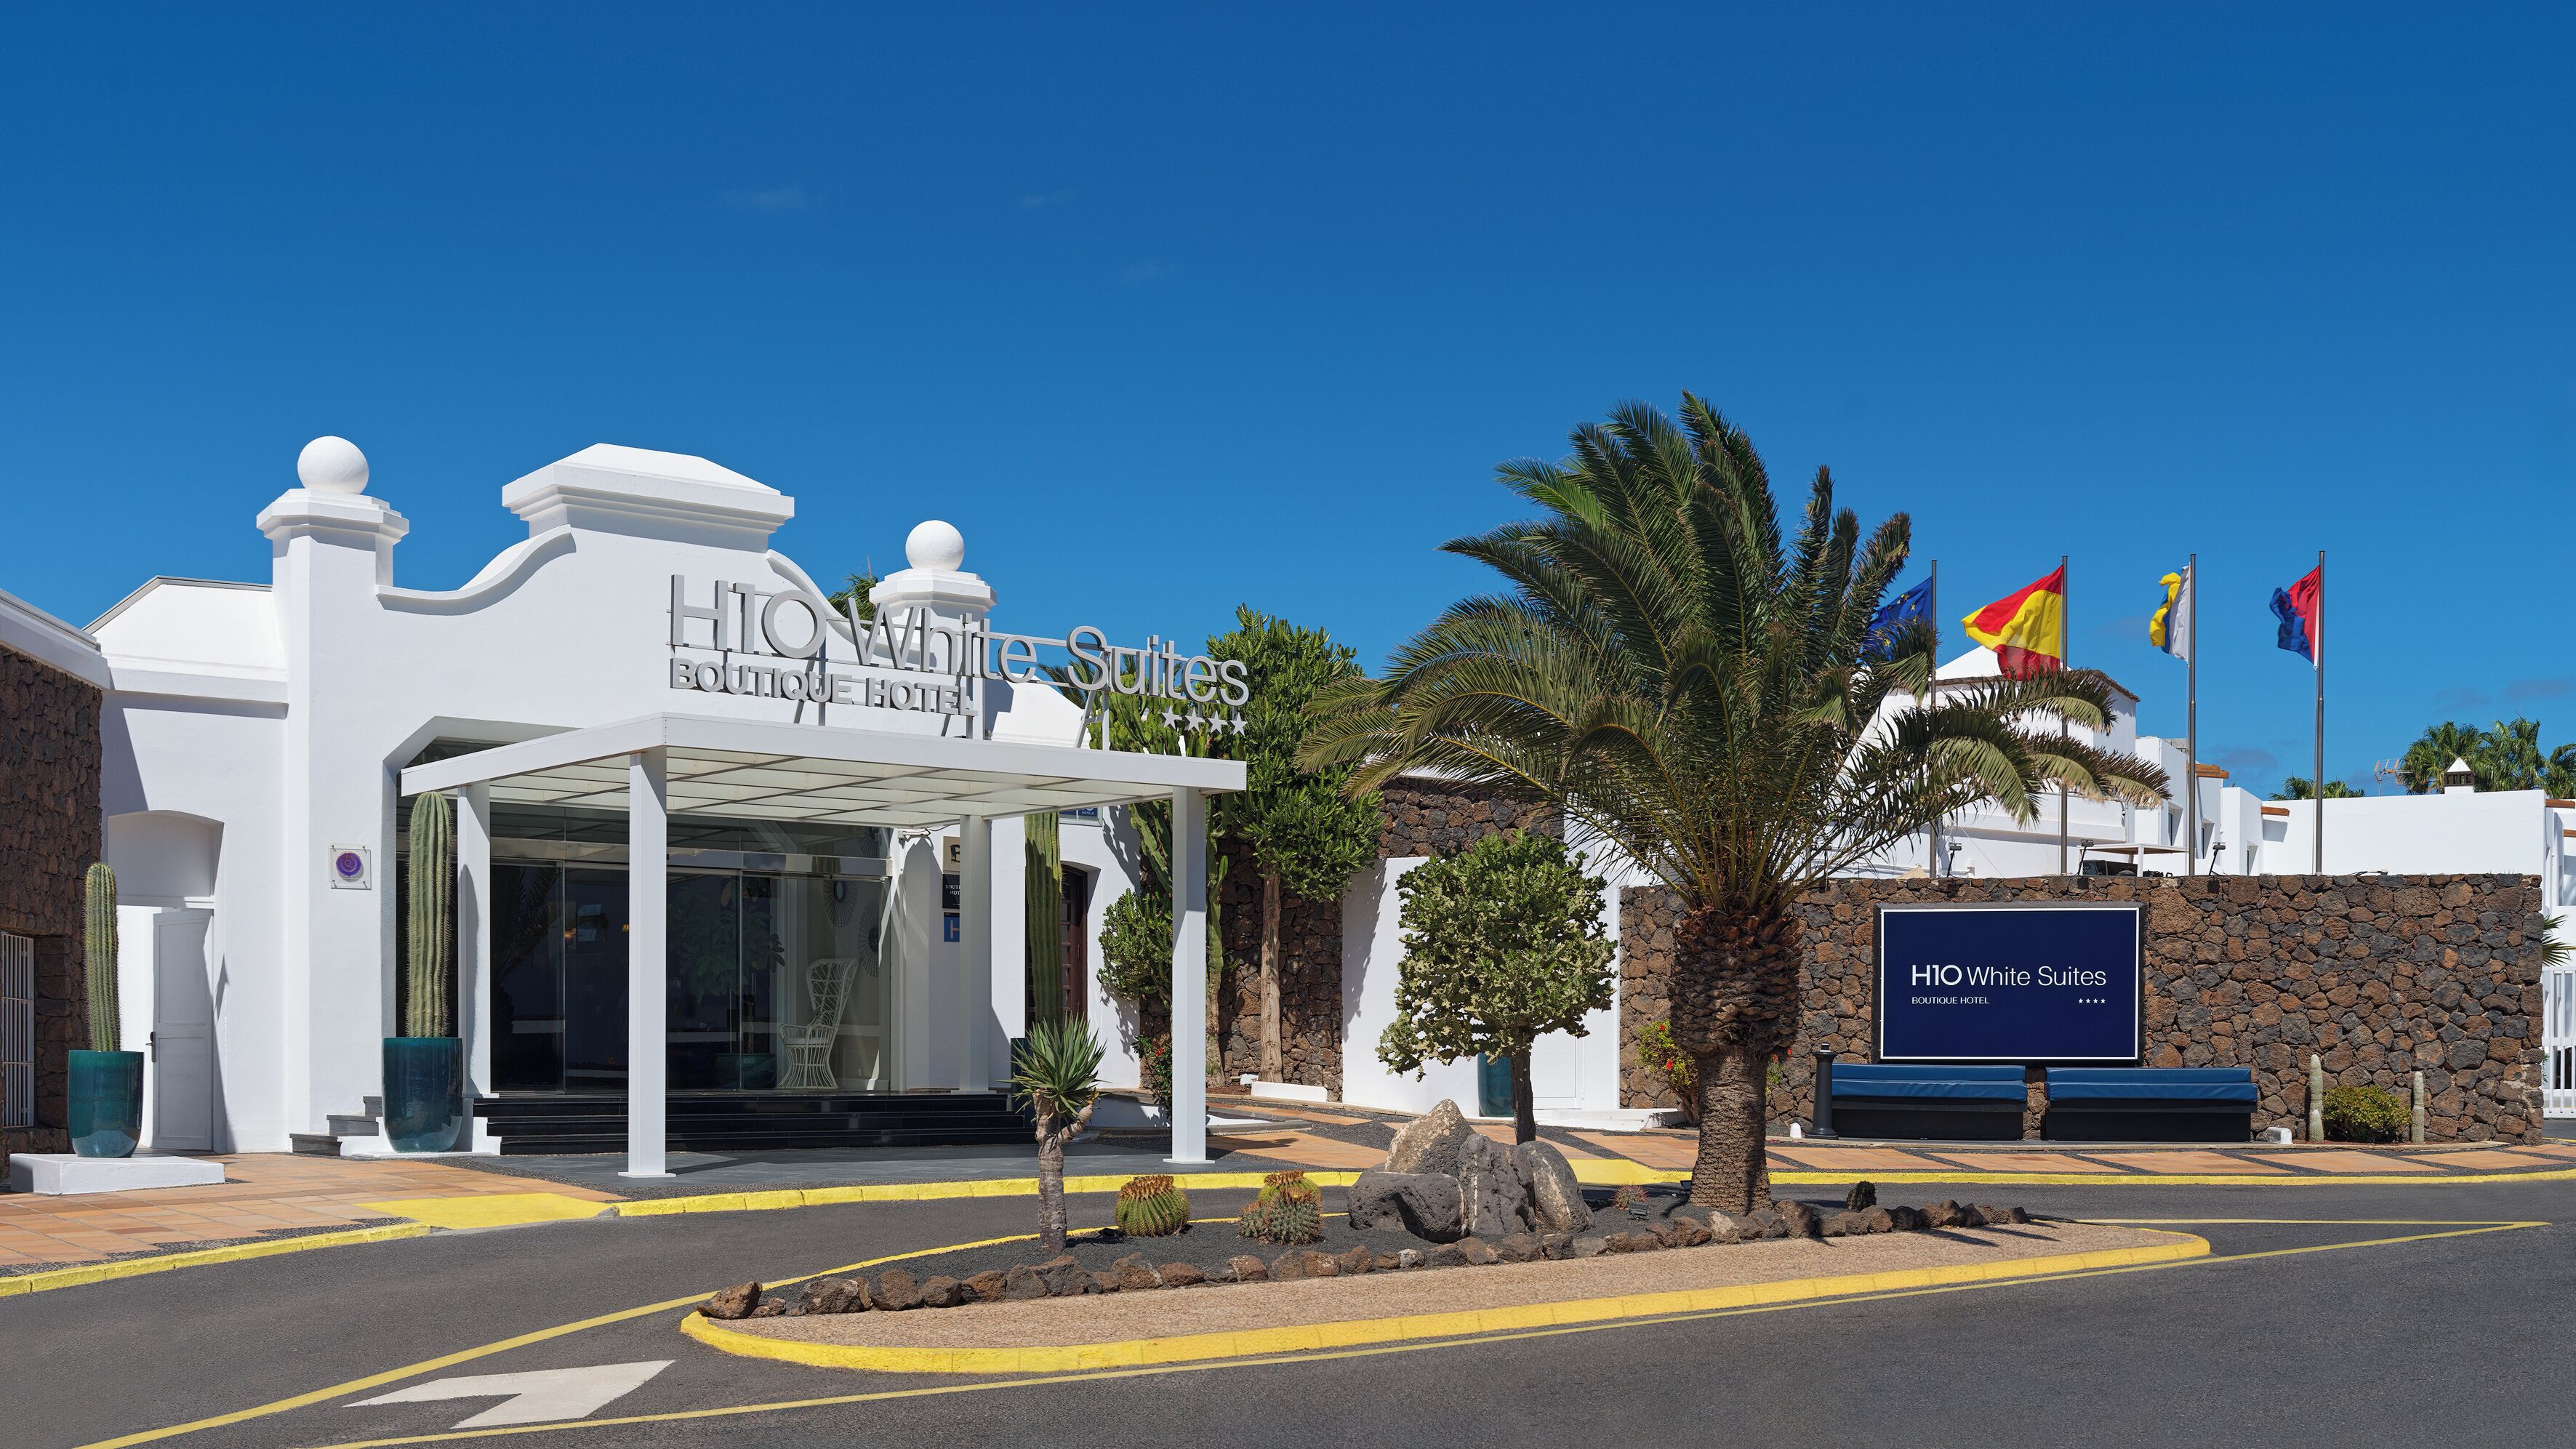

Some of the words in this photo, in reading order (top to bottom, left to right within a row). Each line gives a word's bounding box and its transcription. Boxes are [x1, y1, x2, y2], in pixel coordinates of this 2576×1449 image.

[670, 574, 827, 659] H10
[846, 597, 1039, 684] White
[1067, 625, 1249, 707] Suites
[670, 657, 857, 705] BOUTIQUE
[867, 678, 979, 717] HOTEL
[1911, 965, 1962, 986] H10
[1966, 966, 2031, 986] White
[2037, 966, 2107, 986] Suites
[1911, 996, 1958, 1005] BOUTIQUE
[1959, 996, 1990, 1005] HOTEL
